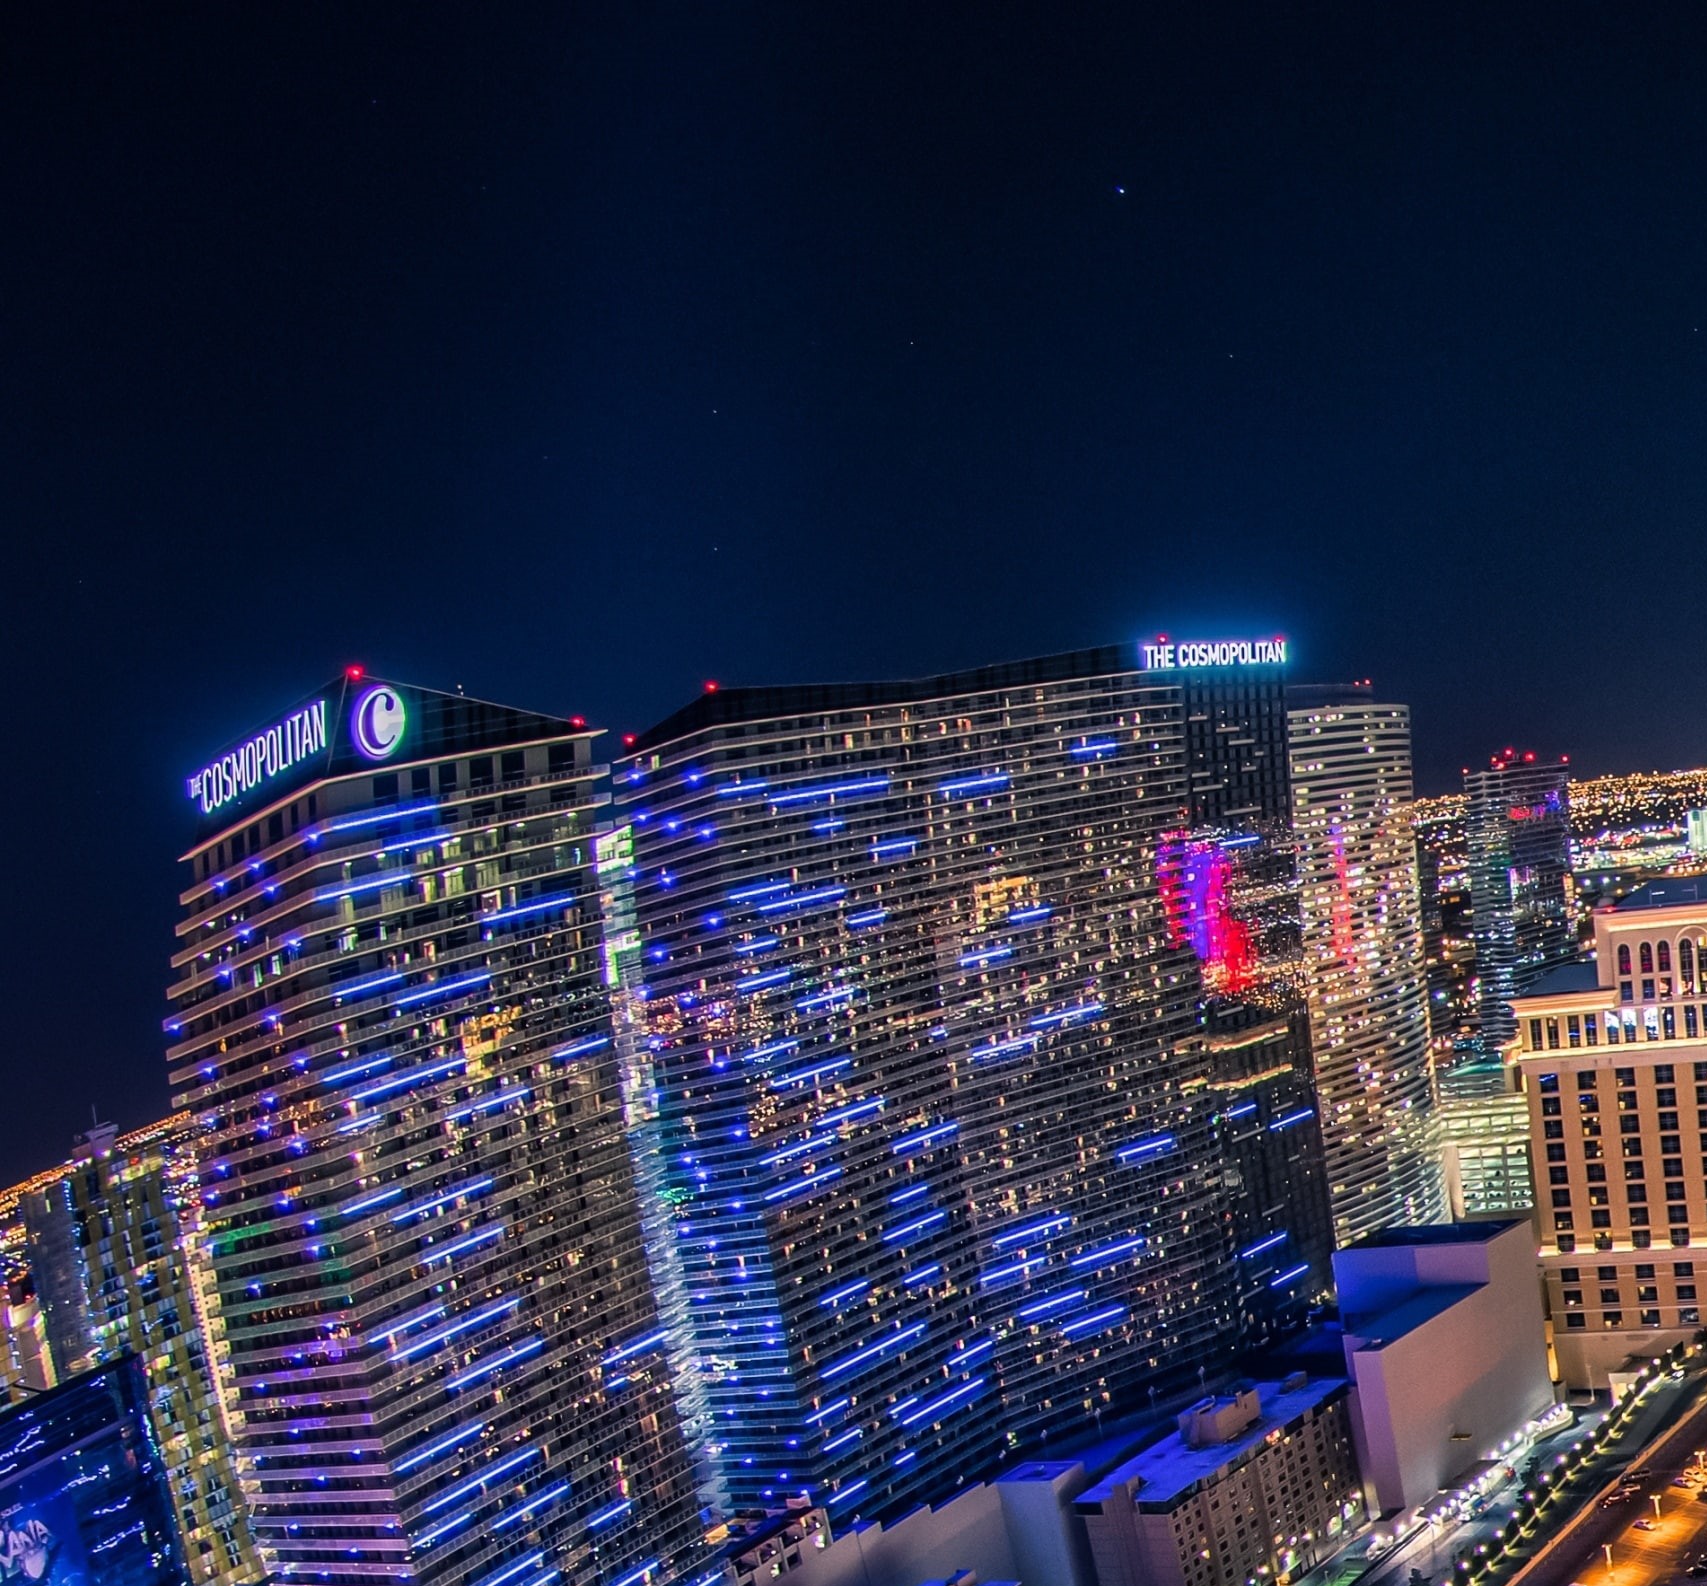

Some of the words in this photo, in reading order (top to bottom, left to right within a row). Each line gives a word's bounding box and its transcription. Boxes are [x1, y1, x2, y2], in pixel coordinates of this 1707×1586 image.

[1143, 645, 1175, 669] THE
[1179, 641, 1286, 667] COSMOPOLITAN
[189, 774, 203, 799] THE
[201, 700, 326, 814] COSMOPOLITAN
